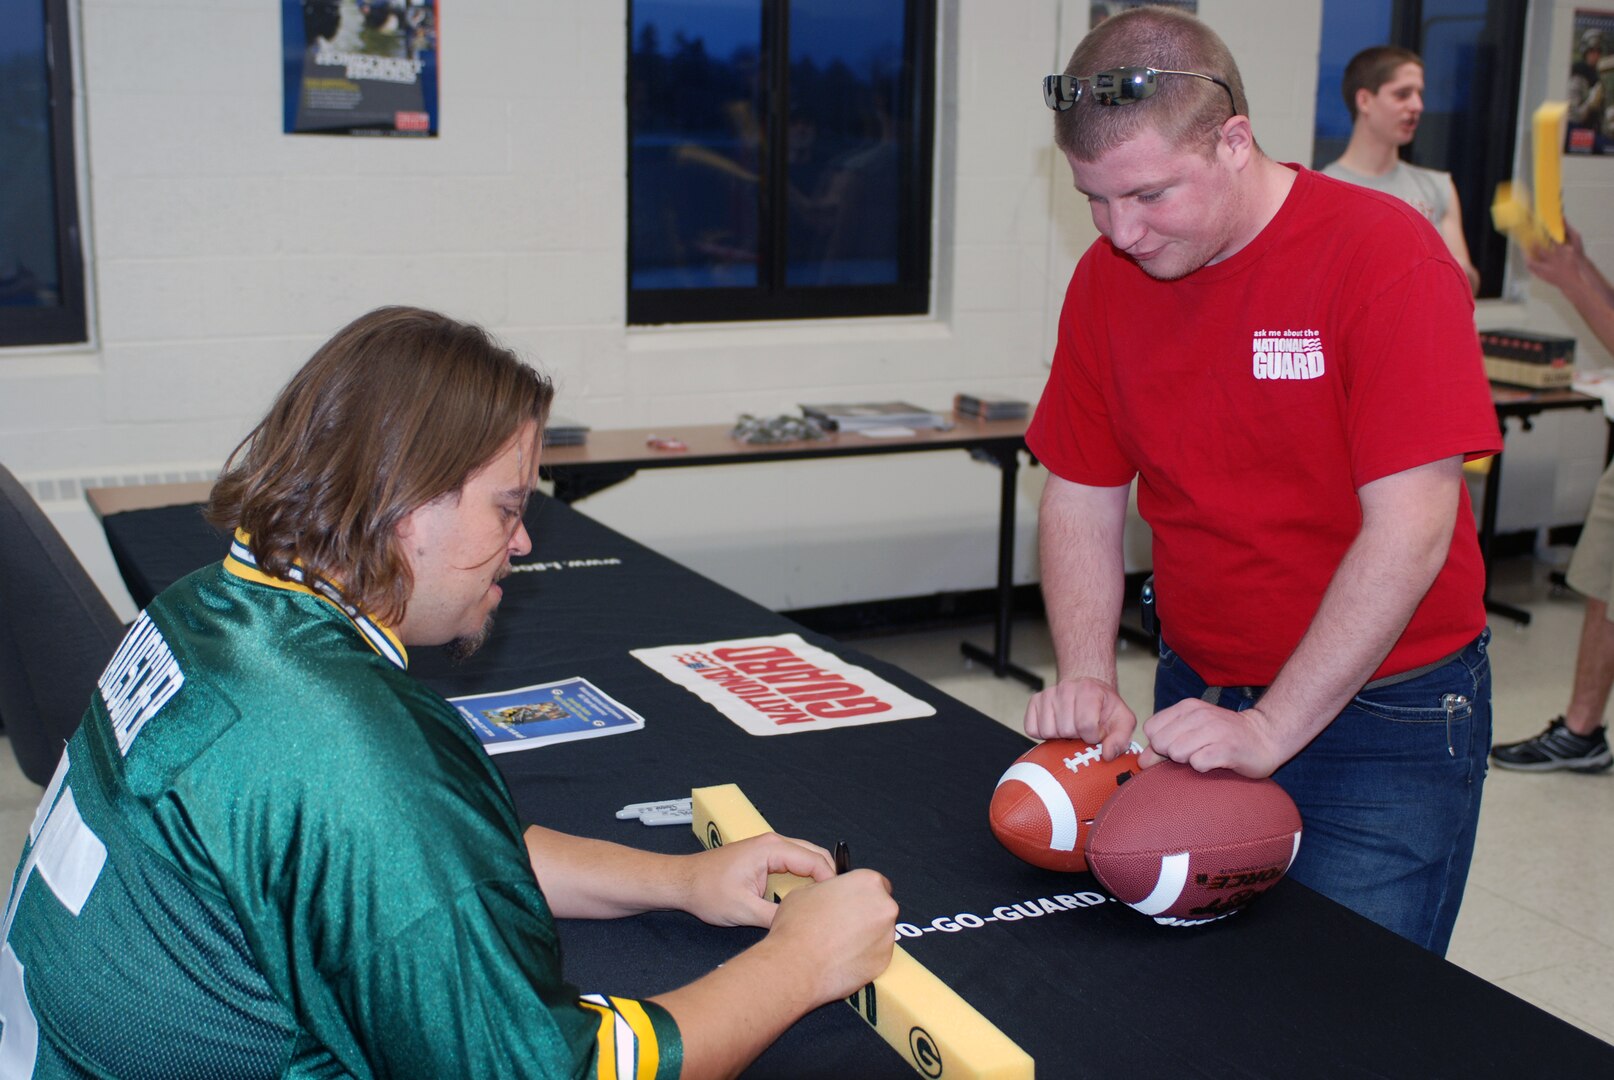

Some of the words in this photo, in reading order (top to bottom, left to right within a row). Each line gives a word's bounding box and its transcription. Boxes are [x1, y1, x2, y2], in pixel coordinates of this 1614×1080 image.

[1253, 338, 1304, 352] NATIONAL
[1254, 329, 1267, 337] ask
[1283, 329, 1303, 337] about
[1304, 329, 1320, 337] the
[1253, 351, 1325, 380] GUARD
[98, 608, 185, 757] TAUSCHER
[694, 666, 818, 726] NATIONAL
[712, 645, 893, 719] GUARD
